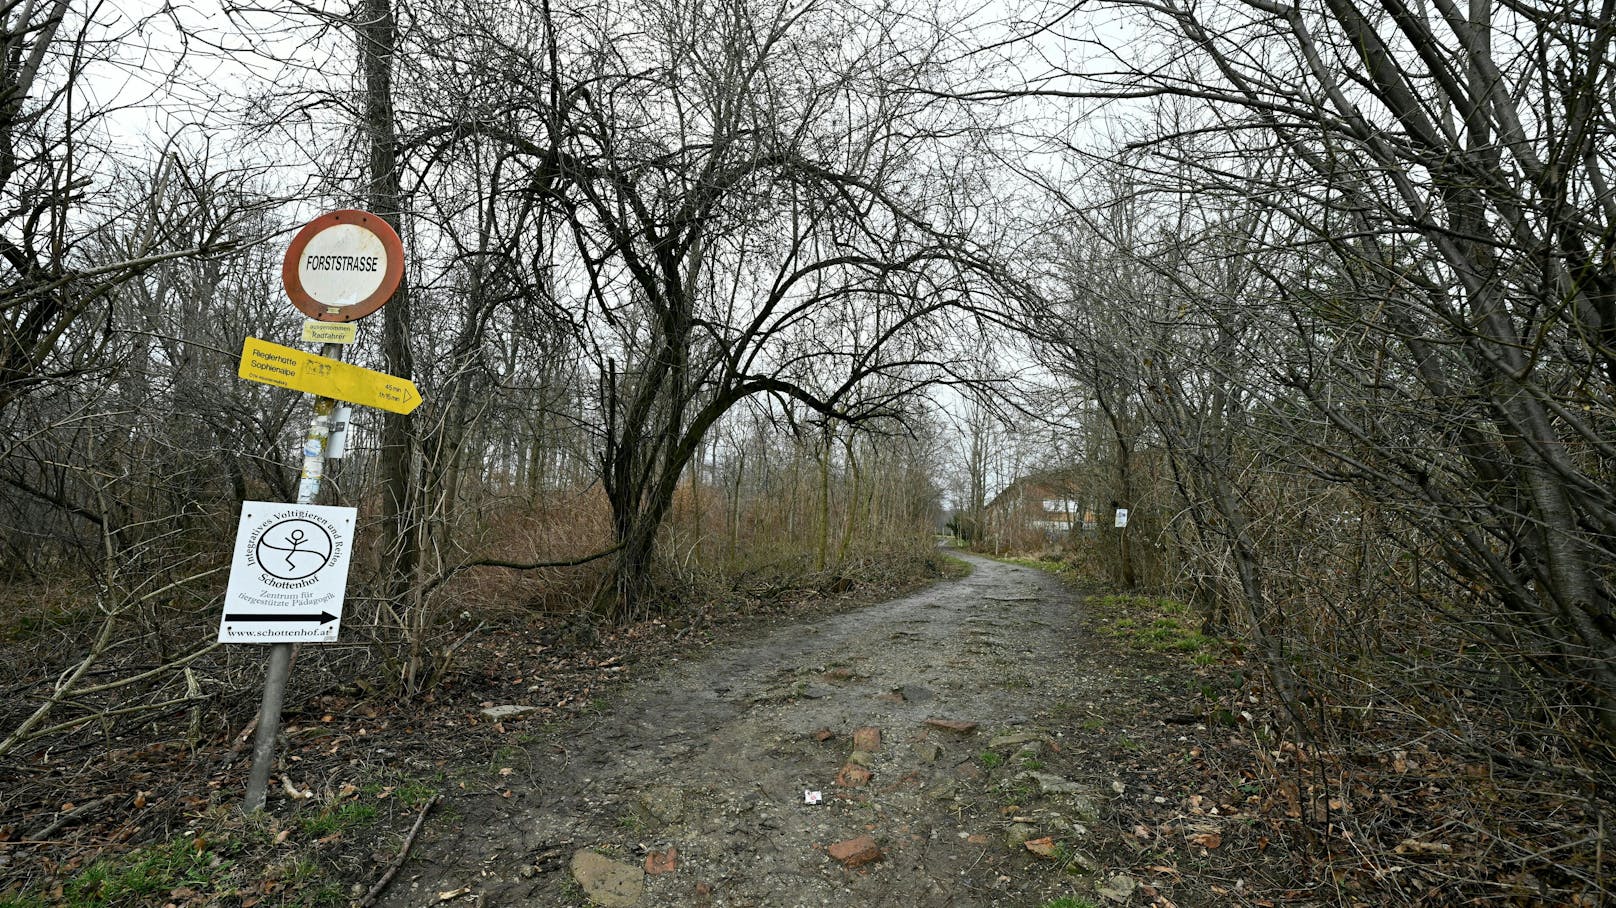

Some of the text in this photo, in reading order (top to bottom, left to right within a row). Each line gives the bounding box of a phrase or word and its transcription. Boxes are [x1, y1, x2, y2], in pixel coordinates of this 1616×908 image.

[306, 255, 378, 272] FORSTSTRASSE
[312, 331, 346, 340] Radfahrer
[251, 360, 296, 377] Sophienalpe
[245, 510, 343, 567] Integratives Voltigieren und Reiten
[258, 573, 319, 590] Schottenhof
[238, 592, 335, 607] tiergestützte Pädagogik
[260, 590, 313, 600] Zentrum für
[228, 628, 330, 637] www.schottenhof.at
